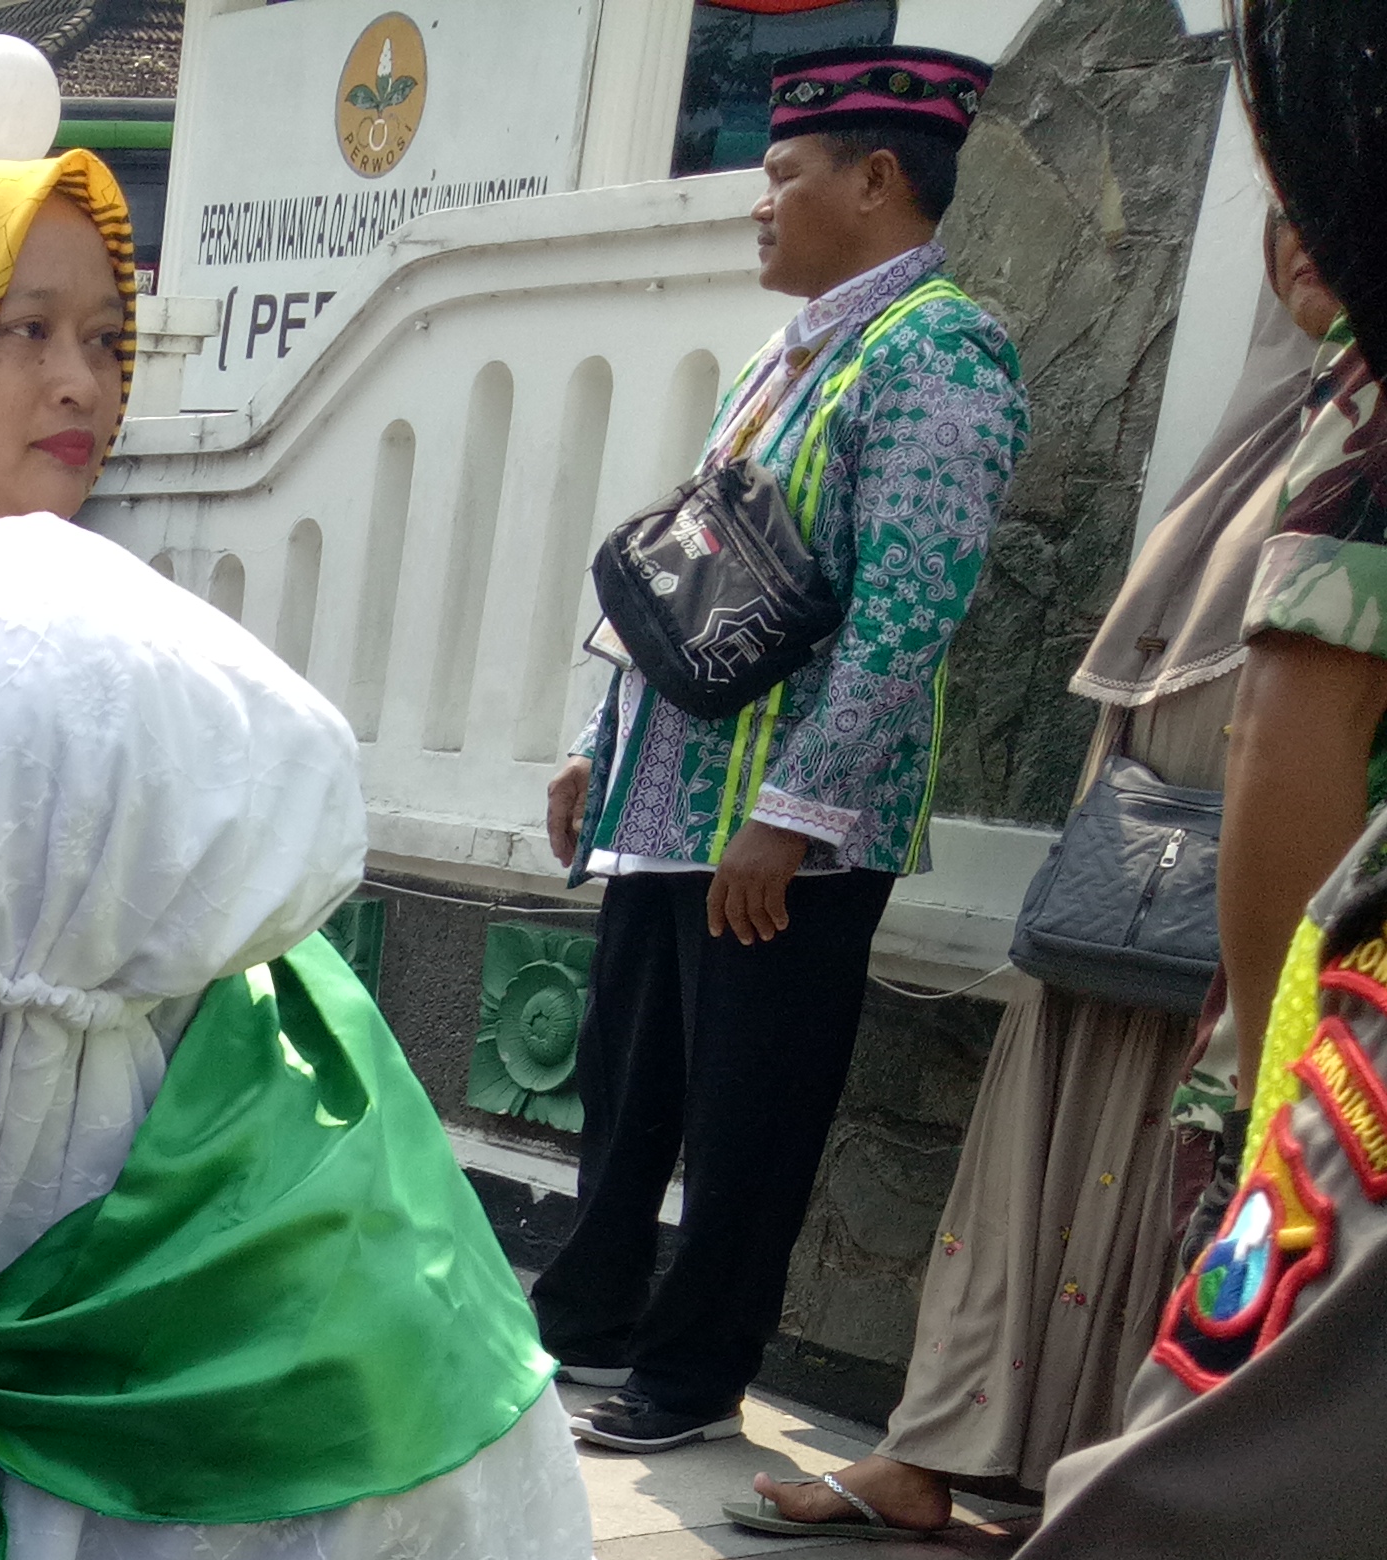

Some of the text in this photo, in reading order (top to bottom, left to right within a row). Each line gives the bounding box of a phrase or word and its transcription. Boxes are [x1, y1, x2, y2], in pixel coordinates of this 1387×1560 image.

[343, 124, 413, 173] PERWOSI
[198, 201, 277, 265] PERSATUAN
[276, 194, 328, 261] WANITA
